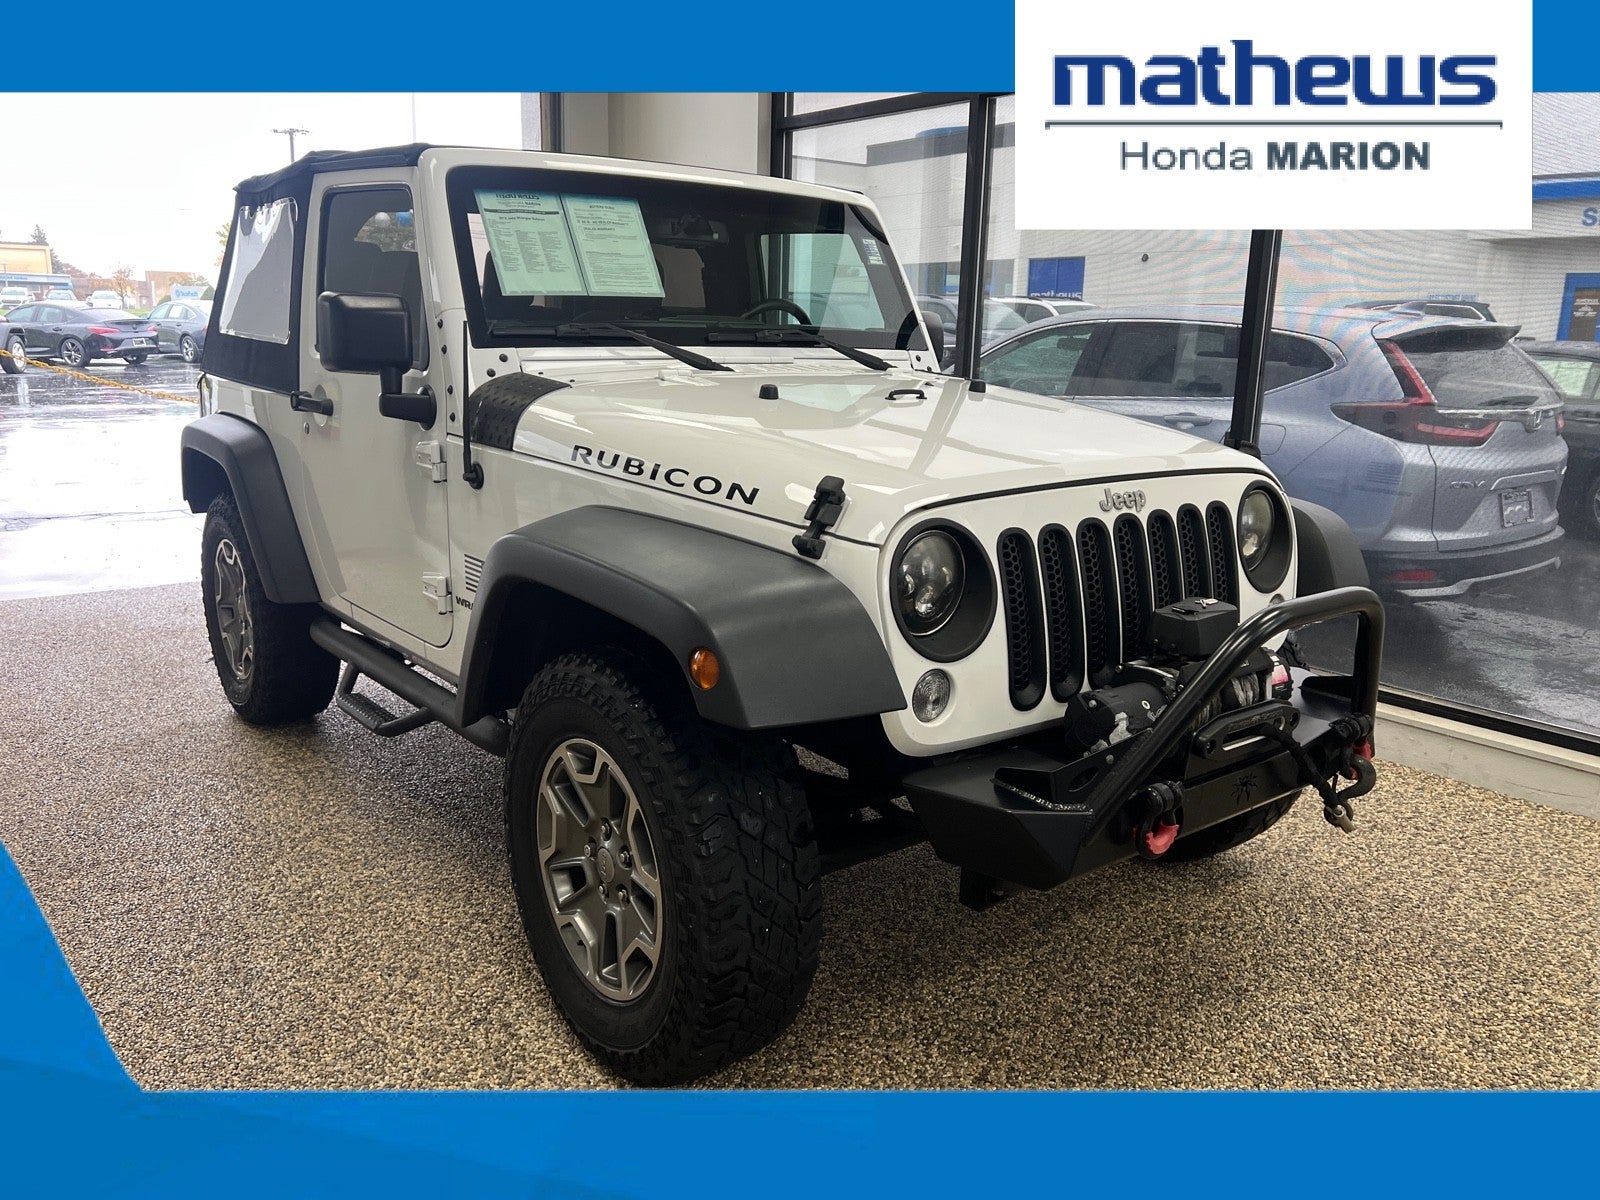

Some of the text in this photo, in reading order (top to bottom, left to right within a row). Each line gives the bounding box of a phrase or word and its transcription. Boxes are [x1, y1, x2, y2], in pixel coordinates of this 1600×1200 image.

[1581, 206, 1600, 227] S
[570, 444, 760, 506] RUBICON
[1099, 487, 1147, 513] Jeep
